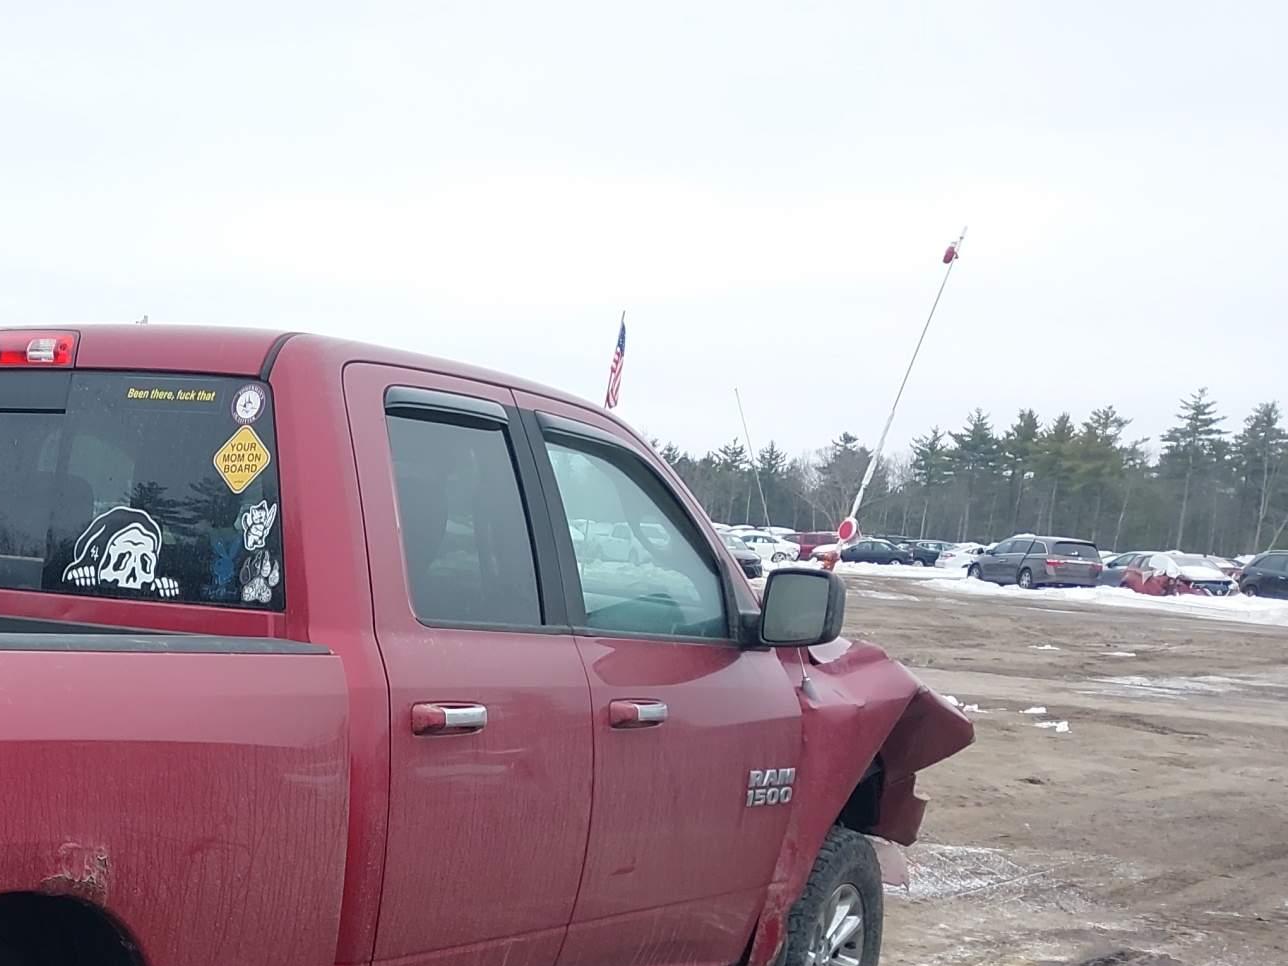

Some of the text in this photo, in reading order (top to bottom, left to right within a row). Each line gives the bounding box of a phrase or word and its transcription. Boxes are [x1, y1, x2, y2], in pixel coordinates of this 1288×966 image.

[127, 387, 216, 401] Been there, fuck that
[231, 442, 257, 452] YOUR
[222, 453, 261, 463] MOM ON
[223, 464, 258, 473] BOARD
[748, 767, 796, 788] RAM
[746, 786, 793, 807] 1500
